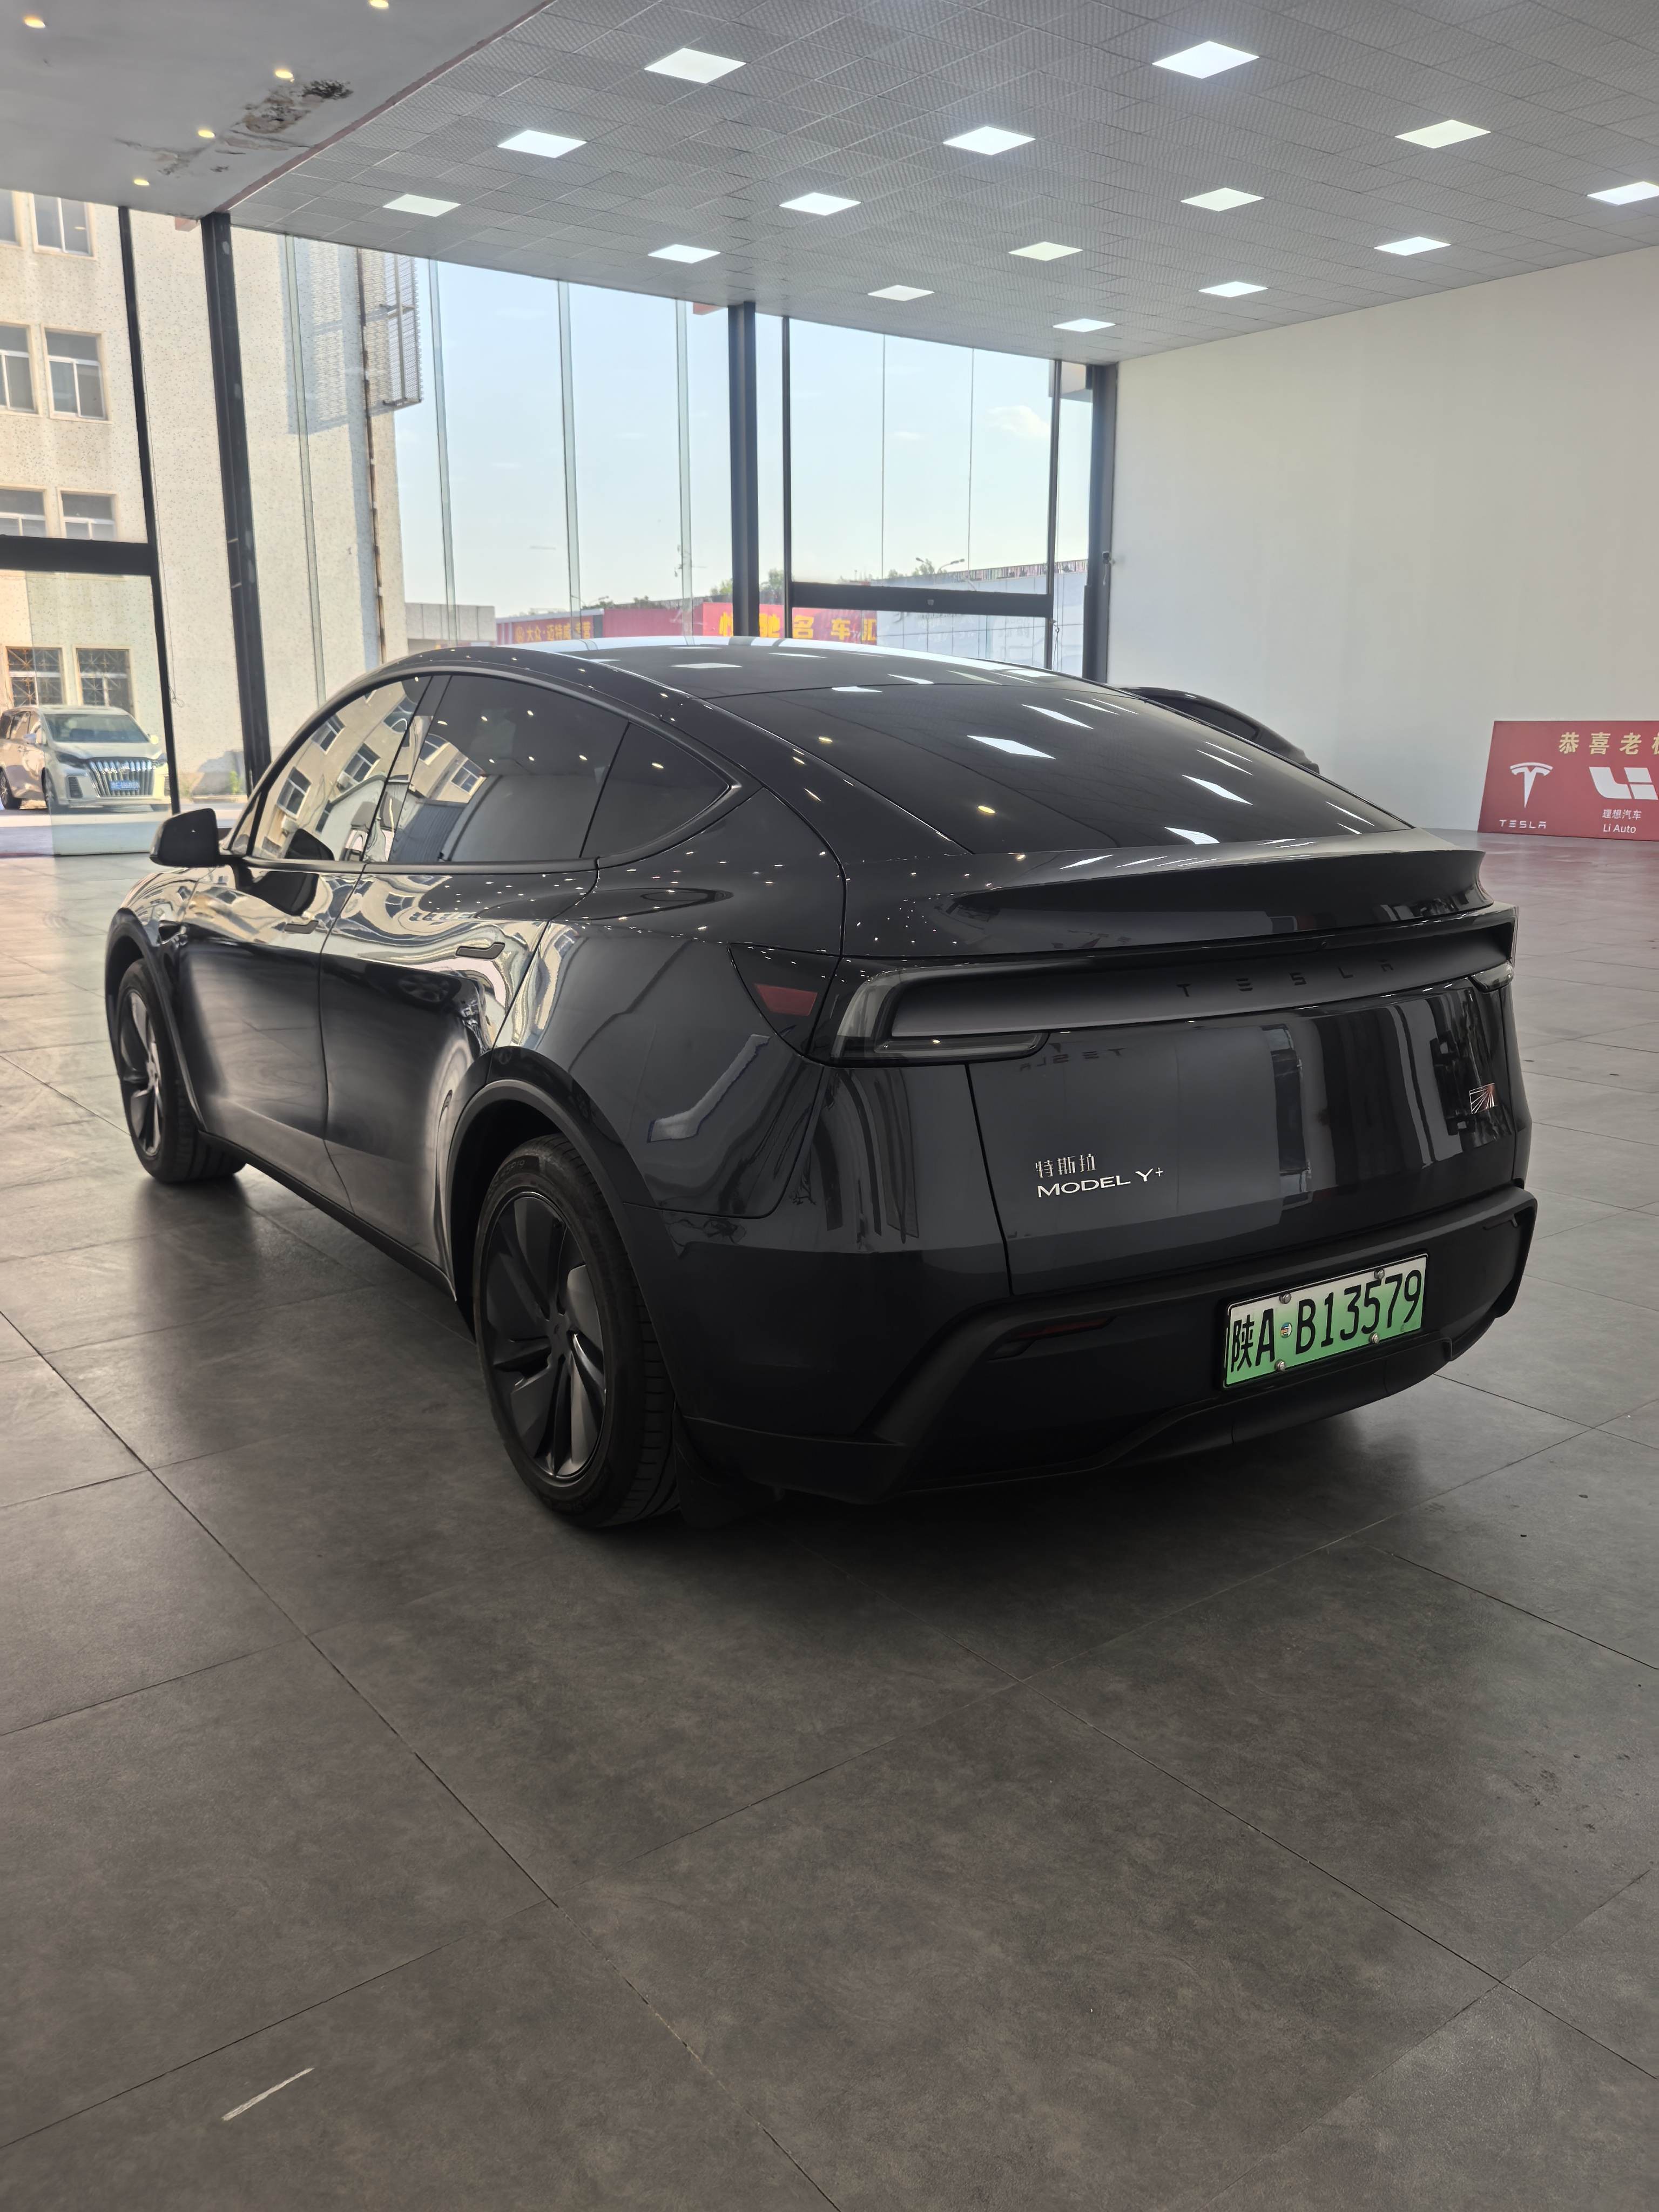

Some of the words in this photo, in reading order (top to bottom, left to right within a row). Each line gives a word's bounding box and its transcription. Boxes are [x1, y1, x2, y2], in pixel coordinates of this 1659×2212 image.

[1602, 809, 1642, 820] 理想汽车
[1499, 820, 1547, 829] TESLA
[1603, 824, 1611, 832] Li
[1613, 824, 1636, 833] Auto
[1176, 959, 1395, 997] TESLA
[1035, 1153, 1096, 1178] 特斯拉
[1037, 1175, 1131, 1198] MODEL
[1135, 1168, 1163, 1182] Y+
